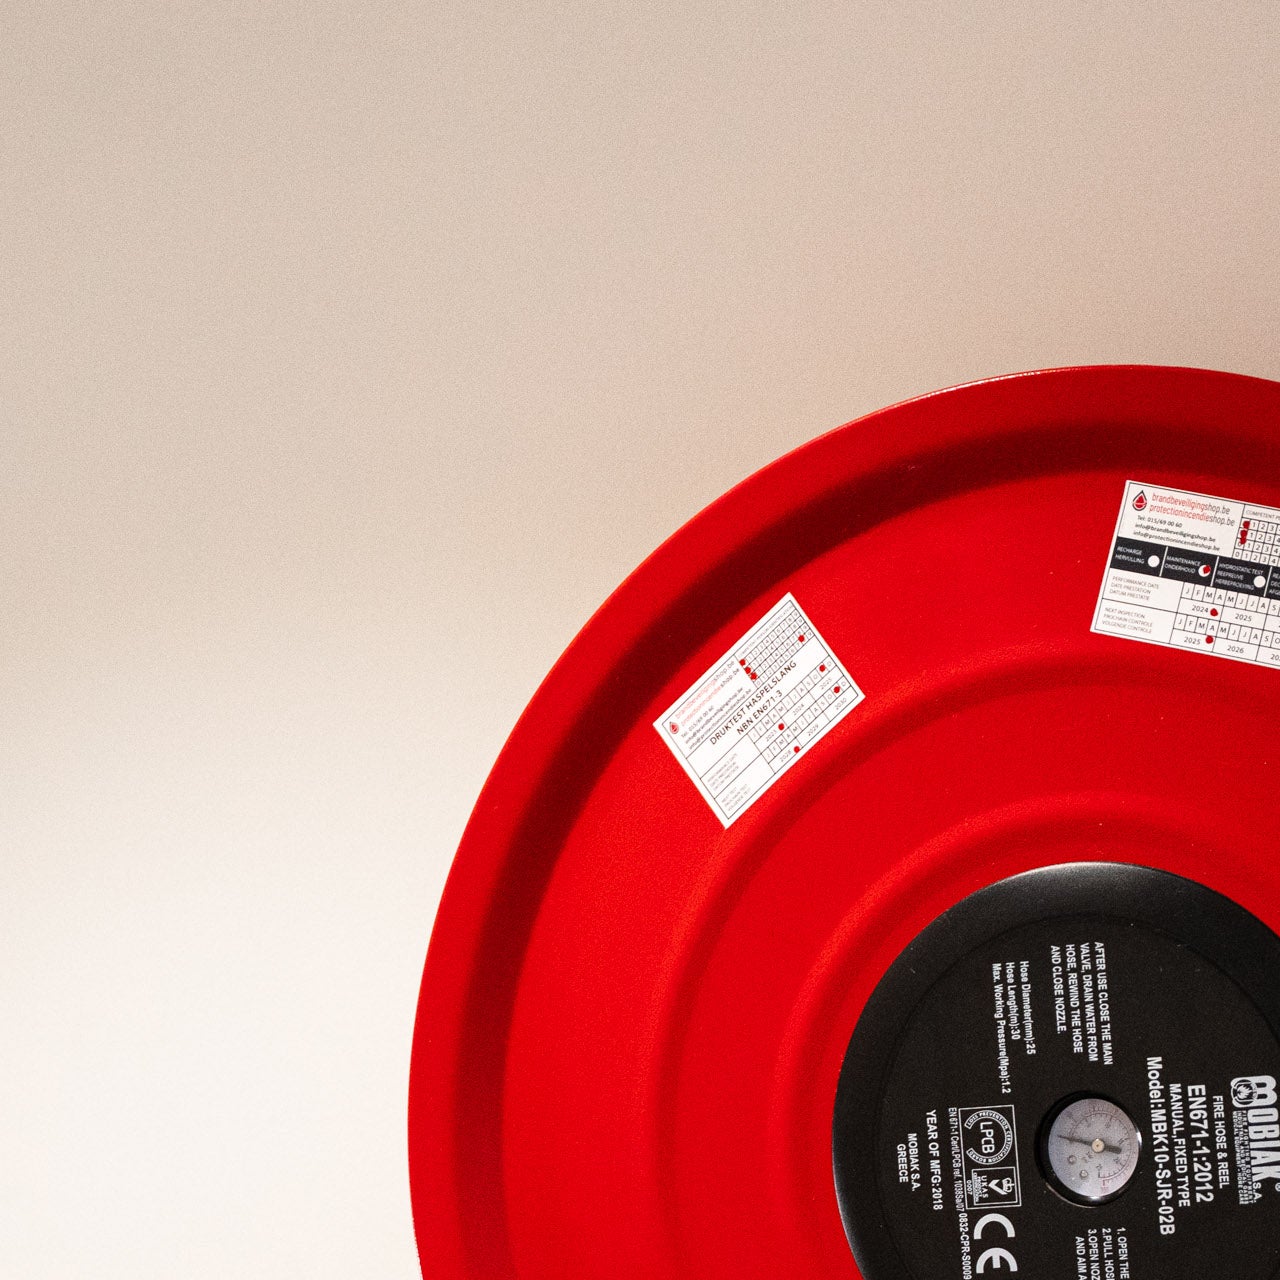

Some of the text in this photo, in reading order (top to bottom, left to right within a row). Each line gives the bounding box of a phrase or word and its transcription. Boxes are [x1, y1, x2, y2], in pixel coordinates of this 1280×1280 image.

[1148, 504, 1236, 527] protectionincendieshop.be
[1151, 492, 1231, 517] brandbeveiligingshop.be
[1245, 509, 1275, 519] COMPETENT
[1147, 516, 1167, 525] 015/69
[1114, 553, 1145, 564] HERVULLING
[1116, 545, 1142, 555] RECHARGE
[1165, 555, 1200, 566] MAINTENANCE
[1112, 575, 1146, 587] PERFORMANCE
[1163, 563, 1196, 574] ONDERHOUD
[1218, 562, 1264, 576] HYDROSTATIC TEST
[1123, 585, 1151, 594] PRESTATION
[1191, 604, 1209, 613] 2024
[1234, 613, 1252, 622] 2025
[1183, 636, 1201, 645] 2025
[1226, 645, 1244, 654] 2026
[709, 707, 746, 745] DRUKTEST
[745, 660, 797, 710] HASPELSLANG
[736, 717, 754, 735] NBN
[752, 689, 783, 720] EN671-3
[1006, 962, 1021, 1040] Hose Length(m):30
[1051, 946, 1066, 1034] AND CLOSE NOZZLE.
[1066, 944, 1083, 1053] HOSE, REWIND THE HOSE
[1080, 943, 1098, 1061] VALVE, DRAIN WATER FROM
[1095, 942, 1113, 1065] AFTER USE CLOSE THE MAIN
[1020, 961, 1036, 1054] Hose Diameter(mm):25
[992, 963, 1011, 1093] Max. Working Pressure(Mpa):1.2
[948, 1107, 957, 1117] EN
[1213, 1096, 1224, 1118] FIRE
[949, 1118, 958, 1134] 671-1
[980, 1122, 995, 1153] LPCB
[1215, 1121, 1227, 1149] HOSE
[951, 1136, 961, 1167] Cert/LPCB
[1147, 1057, 1175, 1235] Model:MBK10-SJR-02B
[1169, 1083, 1190, 1207] MANUAL,FIXED TYPE
[1188, 1085, 1214, 1202] EN671-1:2012
[1242, 1128, 1250, 1161] FIGHTING
[897, 1144, 908, 1182] GREECE
[908, 1133, 921, 1191] MOBIAK S.A.
[926, 1110, 943, 1210] YEAR OF MFG:2018
[953, 1169, 962, 1179] ref.
[980, 1174, 988, 1198] UKAS
[1218, 1162, 1229, 1189] REEL
[1245, 1164, 1253, 1203] EQUIPMENT
[1252, 1181, 1262, 1202] S.A.
[959, 1213, 972, 1280] 0832-CPR-S0009
[1075, 1236, 1085, 1255] AND
[1088, 1229, 1099, 1260] 3.OPEN
[1102, 1228, 1113, 1258] 2.PULL
[1118, 1236, 1128, 1260] OPEN
[1077, 1257, 1087, 1273] AIM
[1120, 1262, 1129, 1279] THE
